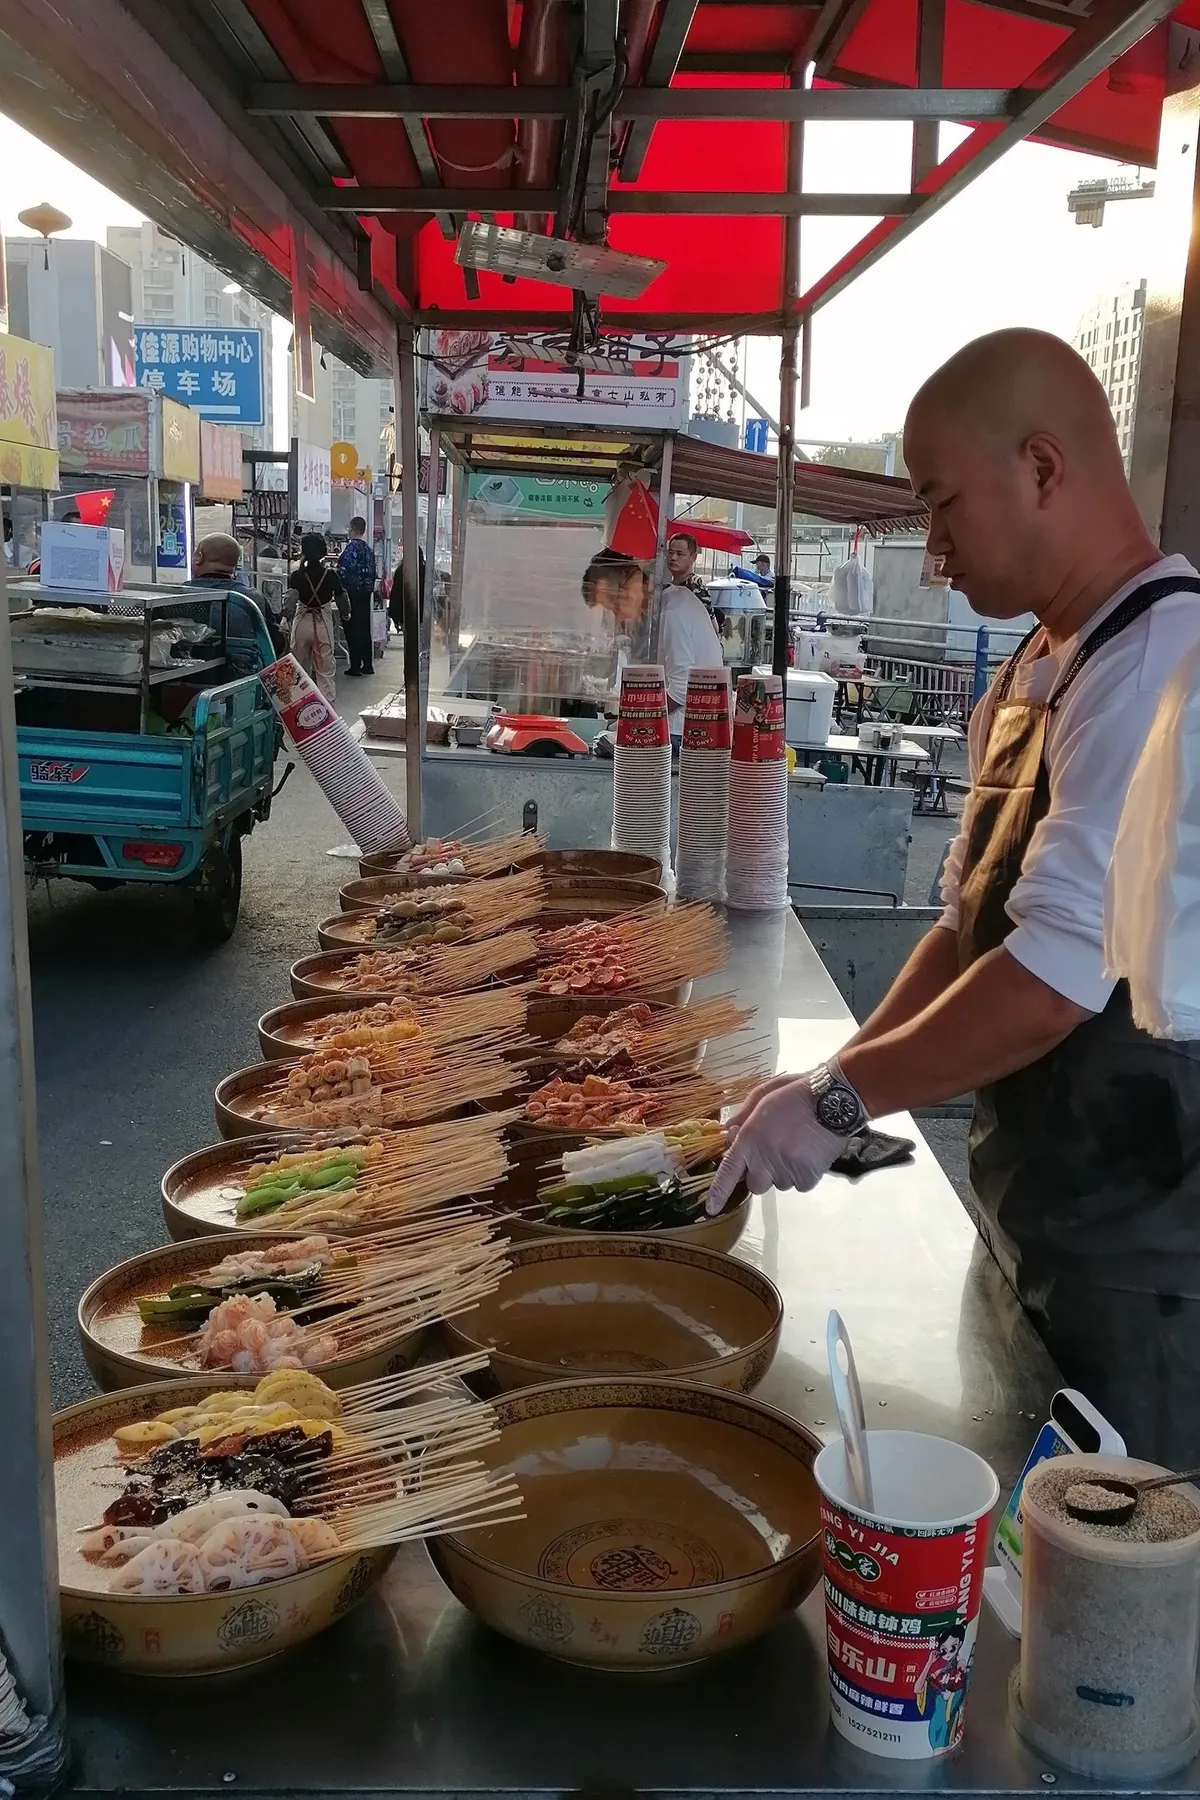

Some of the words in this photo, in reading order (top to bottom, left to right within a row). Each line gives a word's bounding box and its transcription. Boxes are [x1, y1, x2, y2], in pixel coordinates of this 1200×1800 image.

[134, 332, 254, 364] 佳源购物中心
[140, 369, 236, 397] 停车场
[848, 1524, 865, 1543] YI
[869, 1542, 900, 1566] JIA
[962, 1548, 975, 1571] YI
[848, 1717, 901, 1743] 15275212111
